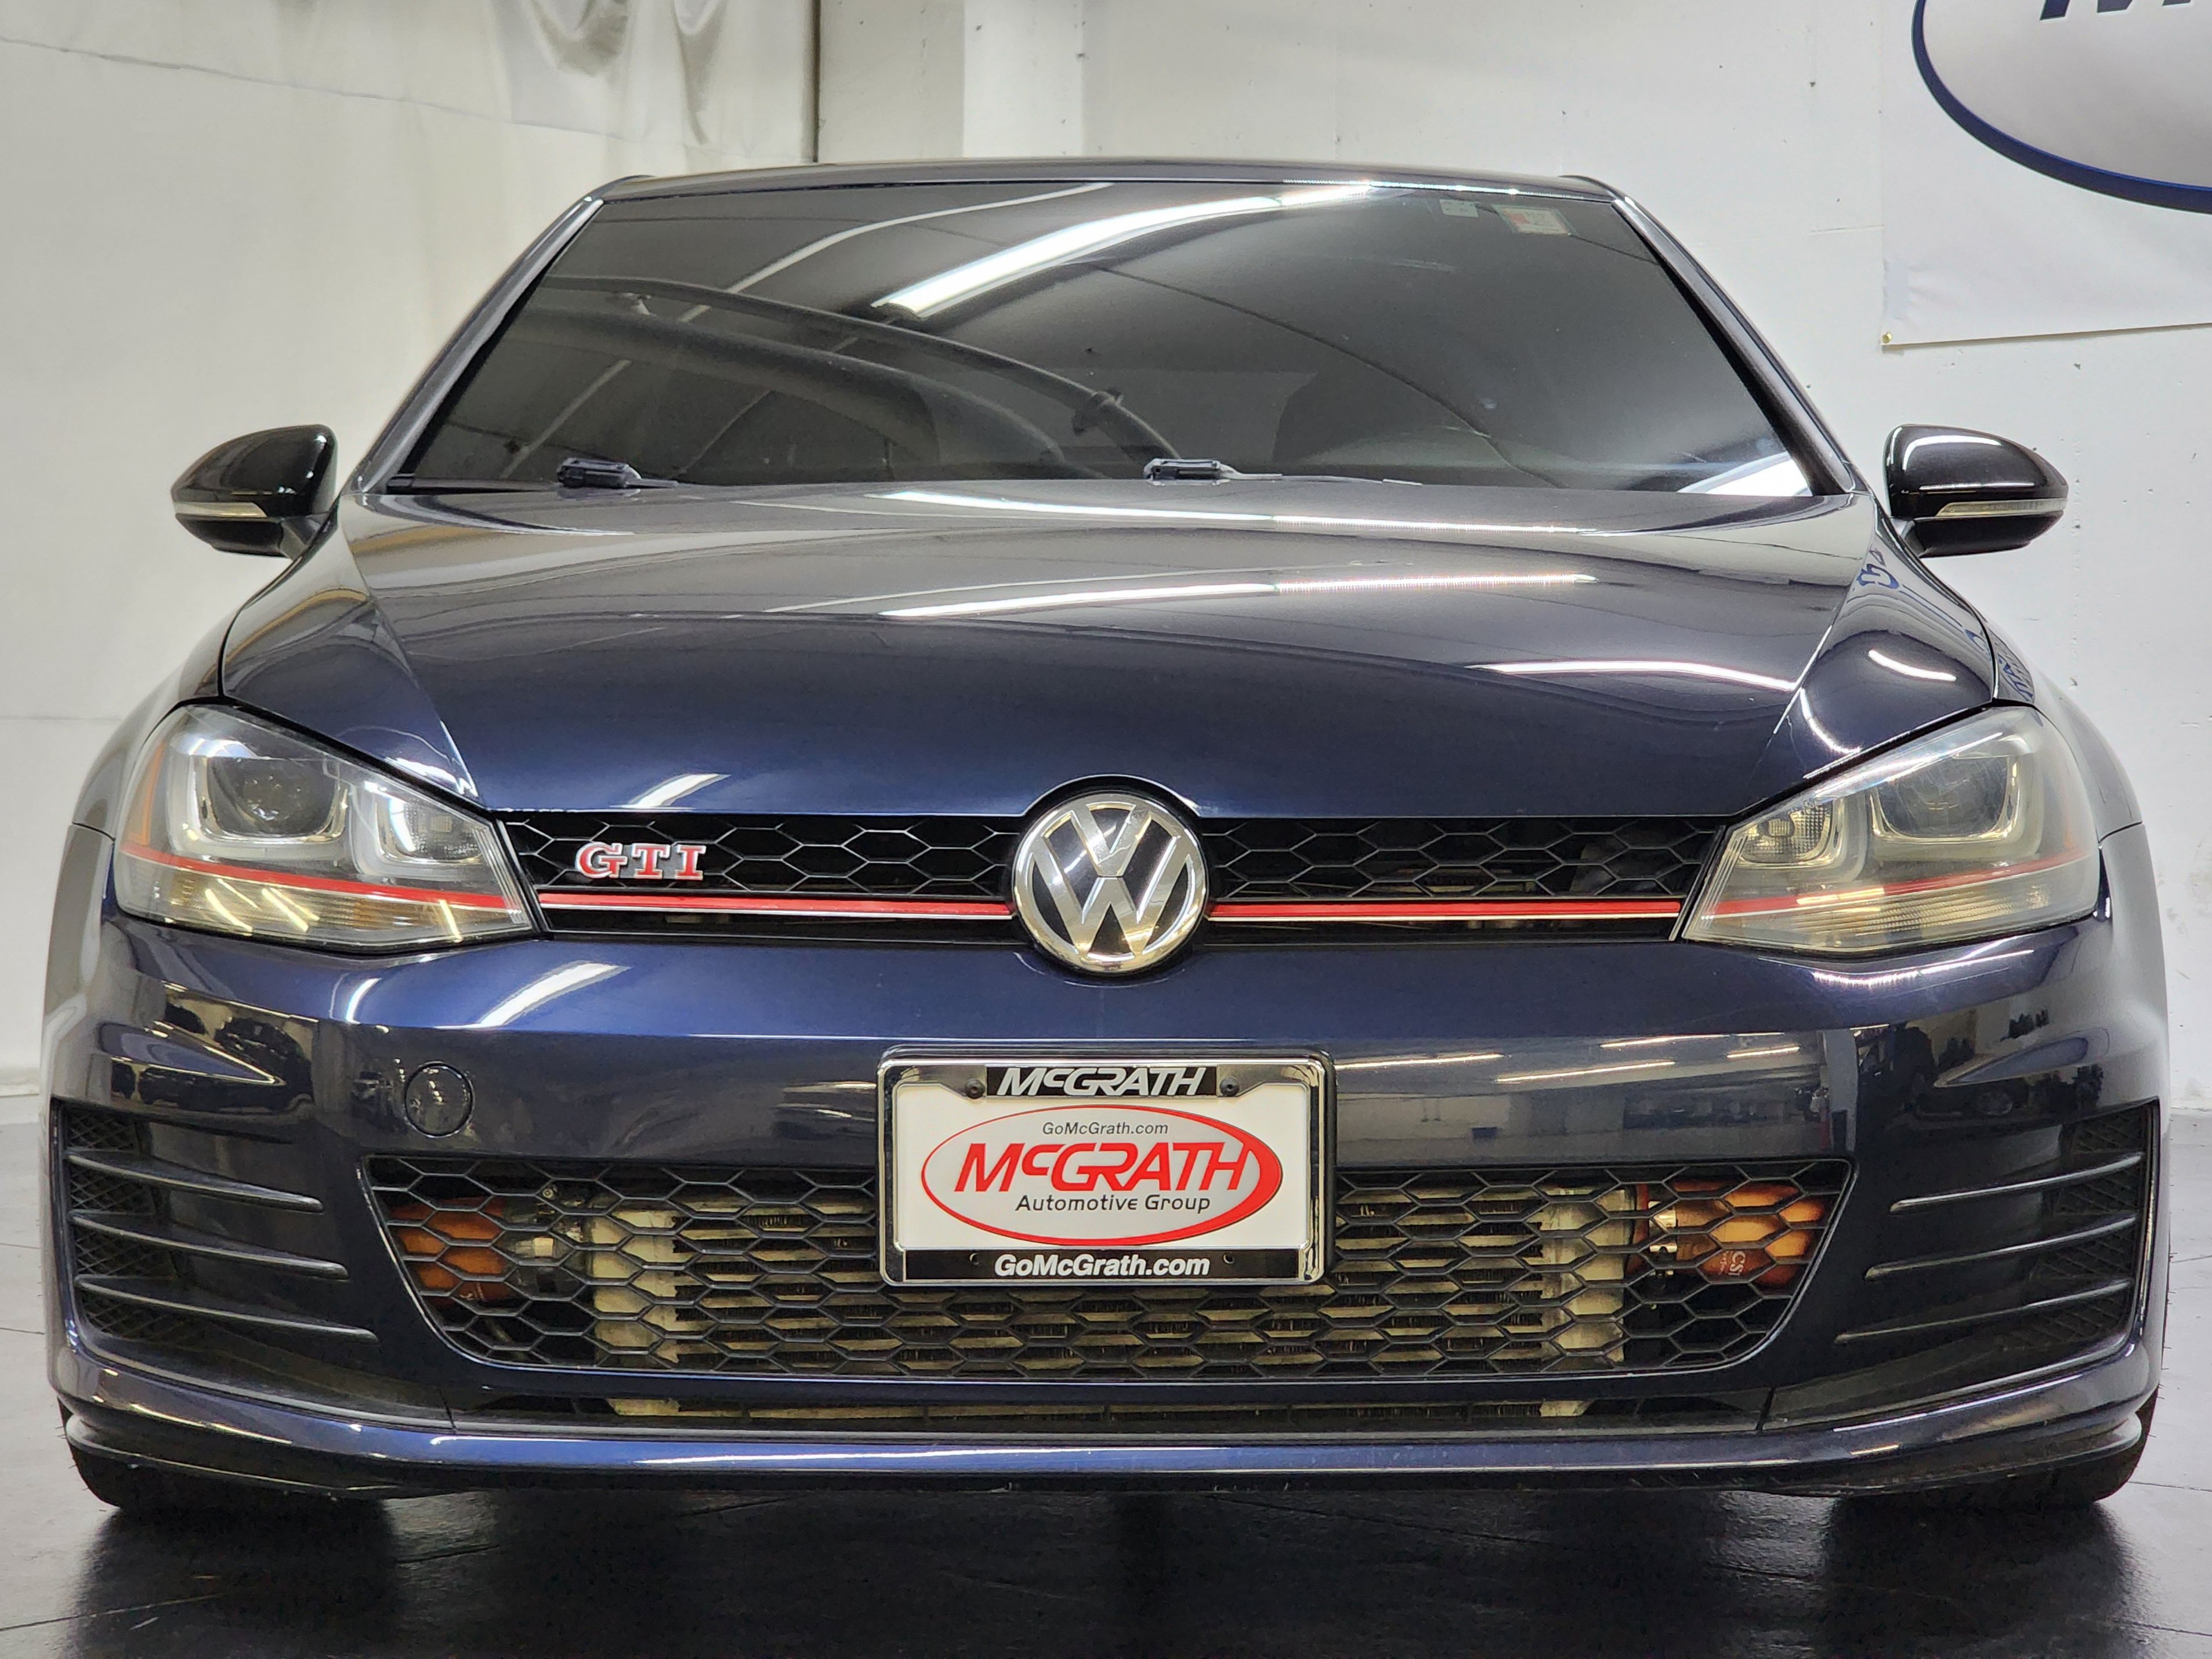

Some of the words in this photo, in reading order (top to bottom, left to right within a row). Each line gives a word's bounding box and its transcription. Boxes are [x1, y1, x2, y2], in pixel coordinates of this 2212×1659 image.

[575, 841, 707, 881] GTI
[1042, 1121, 1168, 1135] GoMcGrath.com
[1015, 1194, 1138, 1212] Automotive
[1145, 1194, 1211, 1214] Group
[994, 1253, 1211, 1277] GoMcGrath.com
